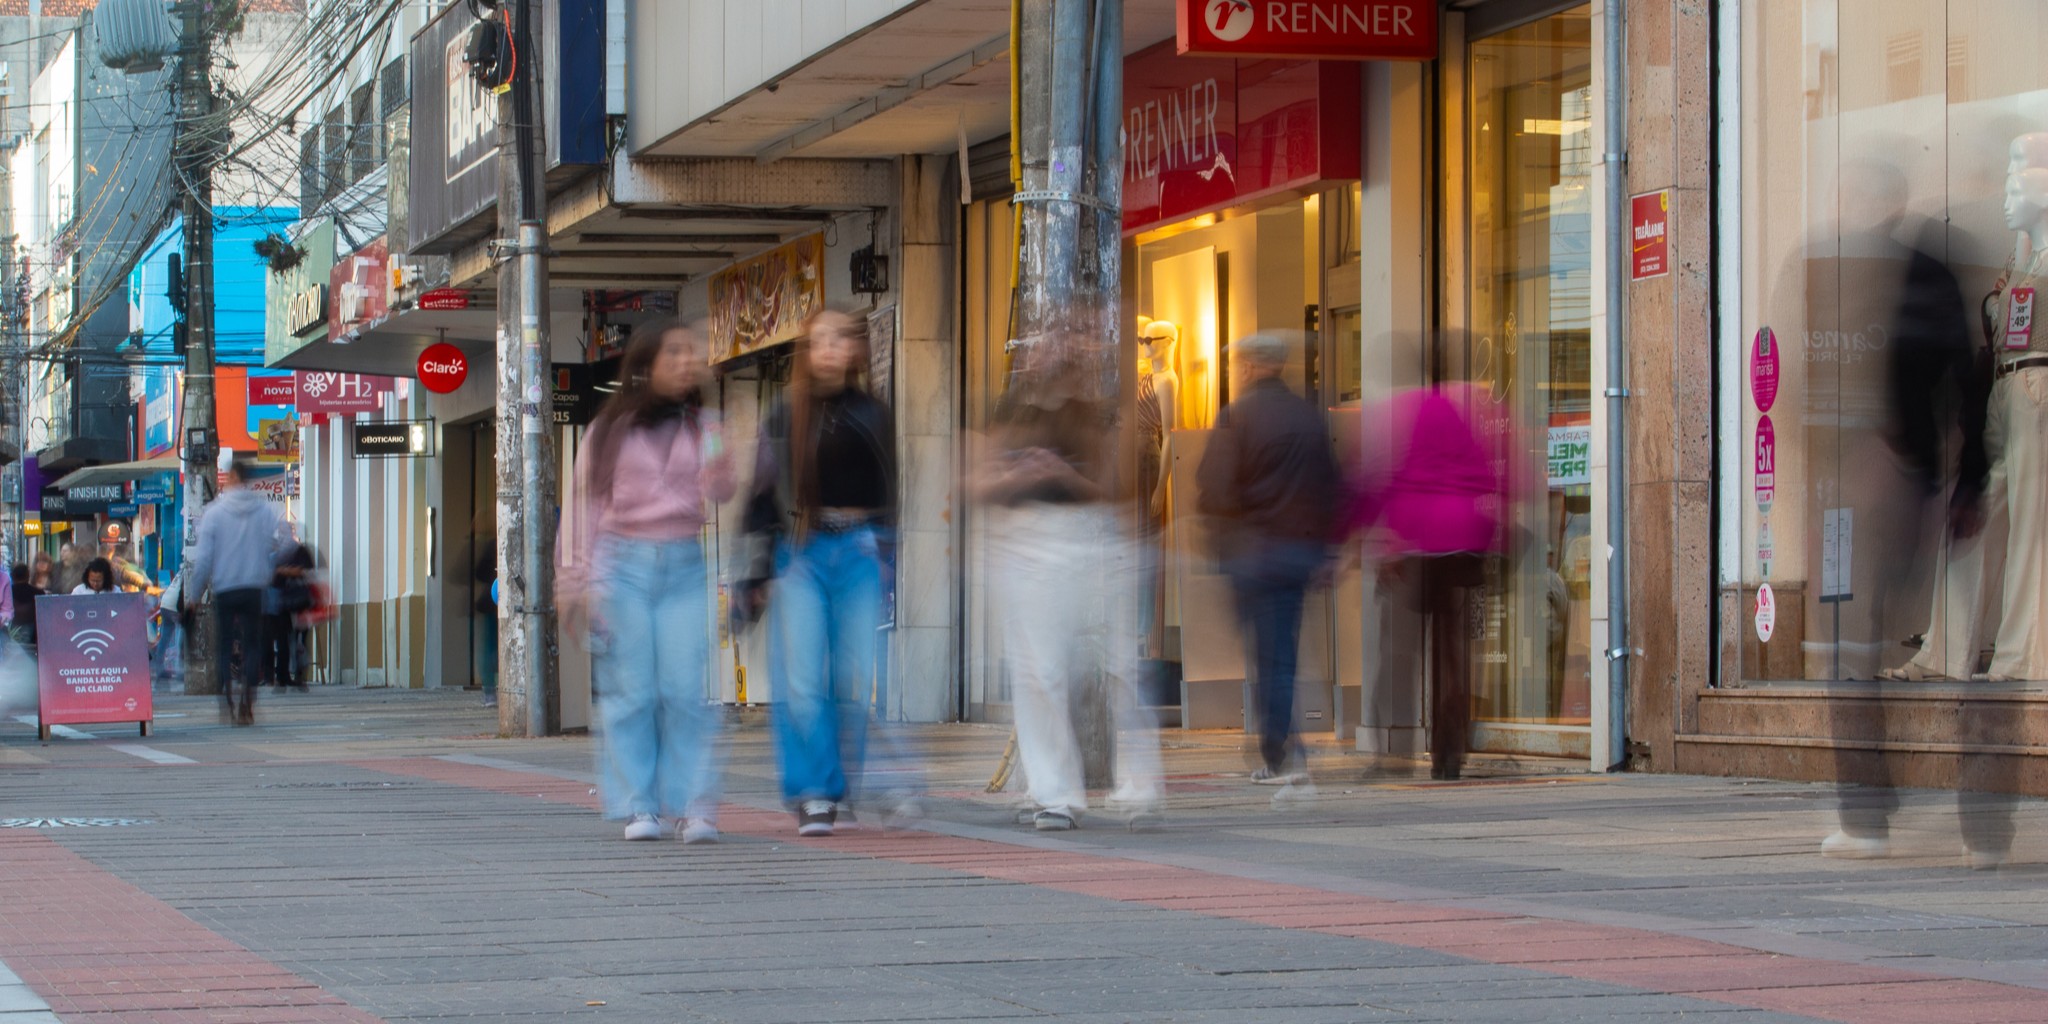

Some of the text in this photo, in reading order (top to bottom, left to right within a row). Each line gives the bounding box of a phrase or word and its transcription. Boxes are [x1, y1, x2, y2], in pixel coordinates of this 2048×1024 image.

[1267, 3, 1415, 37] RENNER
[1130, 77, 1218, 183] RENNER
[423, 359, 463, 375] Claro
[552, 392, 579, 402] Capas
[68, 487, 120, 498] FINISH LINE
[59, 668, 100, 676] CONTRATE
[101, 667, 121, 676] AQUI
[66, 676, 122, 685] BANDA LARGA
[88, 685, 114, 693] CLARO
